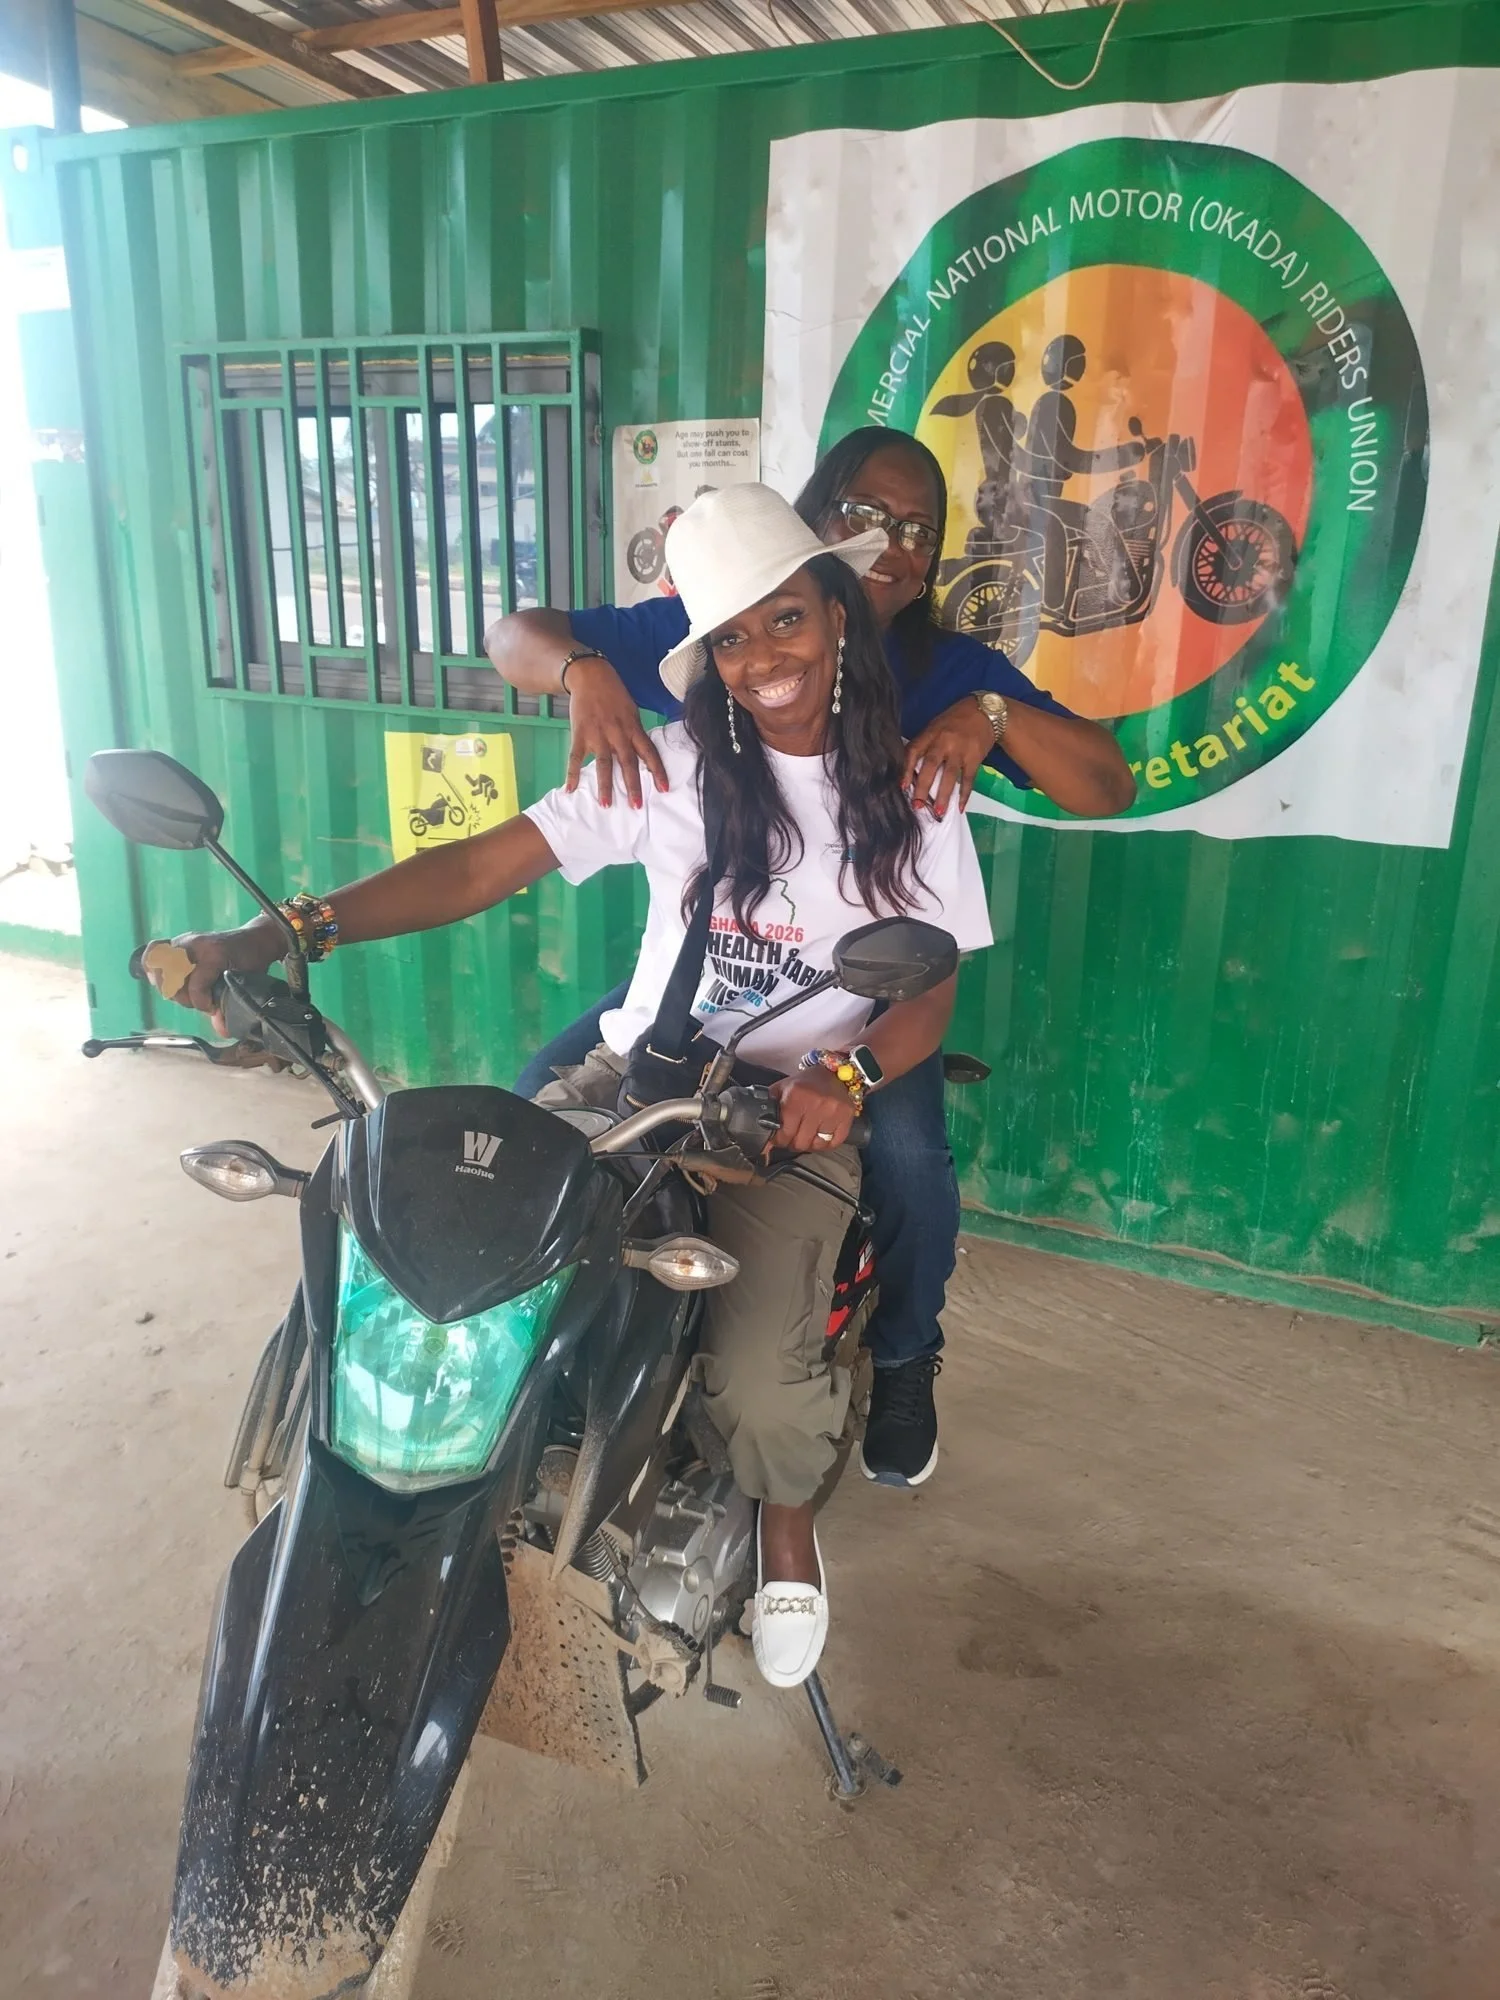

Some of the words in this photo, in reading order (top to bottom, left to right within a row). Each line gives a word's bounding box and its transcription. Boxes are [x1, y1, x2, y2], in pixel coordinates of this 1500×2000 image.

[926, 206, 1061, 311] NATIONAL
[1069, 188, 1183, 224] MOTOR
[1189, 195, 1309, 289] (OKADA)
[1300, 281, 1368, 390] RIDERS
[1347, 396, 1378, 511] UNION
[675, 431, 689, 440] Age
[690, 431, 704, 439] may
[705, 429, 724, 438] push
[725, 430, 740, 438] you
[683, 439, 714, 448] show-off
[677, 450, 688, 458] But
[704, 448, 716, 457] fall
[688, 461, 701, 469] you
[709, 916, 760, 937] GHAA
[765, 923, 804, 942] 2026
[707, 931, 783, 965] HEALTH
